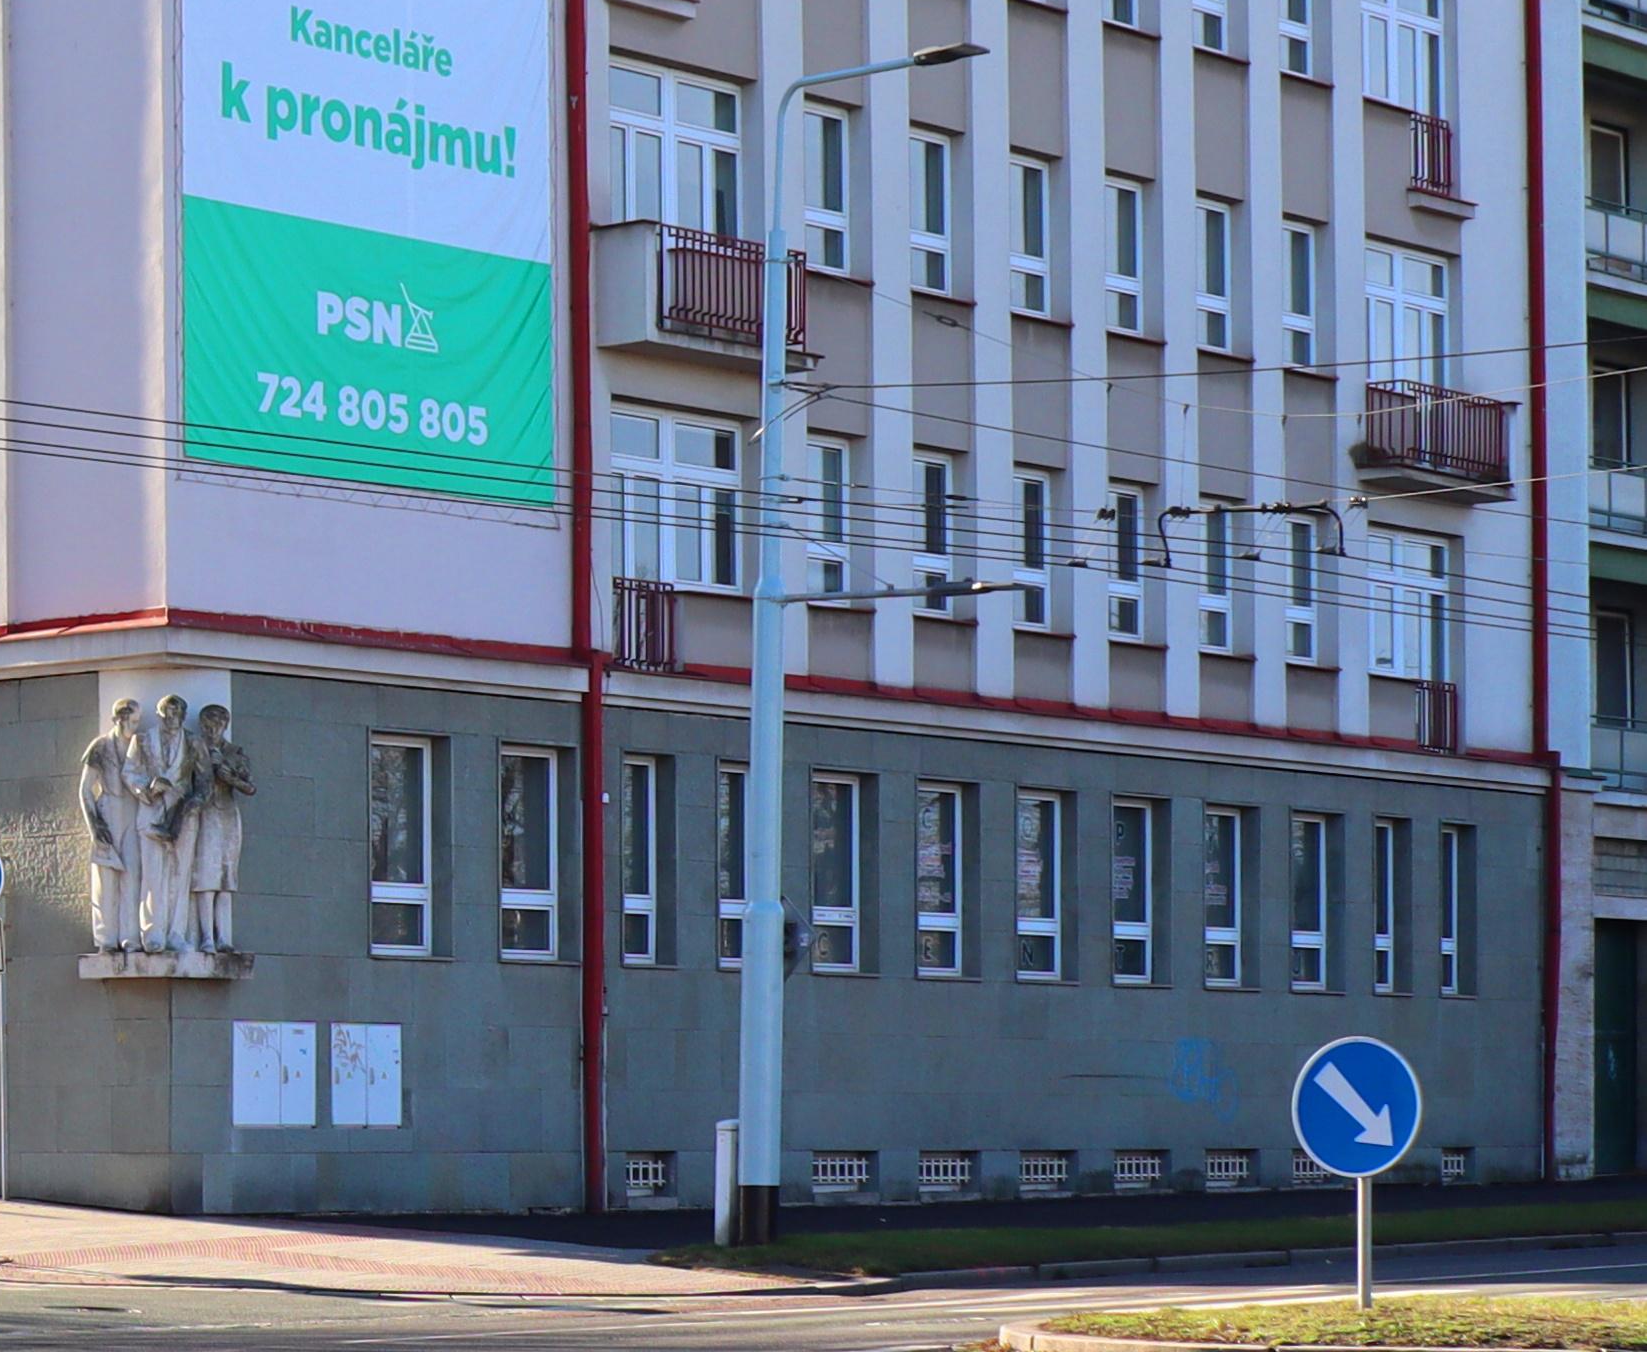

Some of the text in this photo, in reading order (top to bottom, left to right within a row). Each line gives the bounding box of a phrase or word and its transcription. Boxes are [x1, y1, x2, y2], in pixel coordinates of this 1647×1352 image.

[290, 6, 453, 77] Kanceláře
[221, 61, 517, 179] k pronájmu!
[317, 290, 402, 347] PSN
[257, 372, 488, 446] 724 805 805
